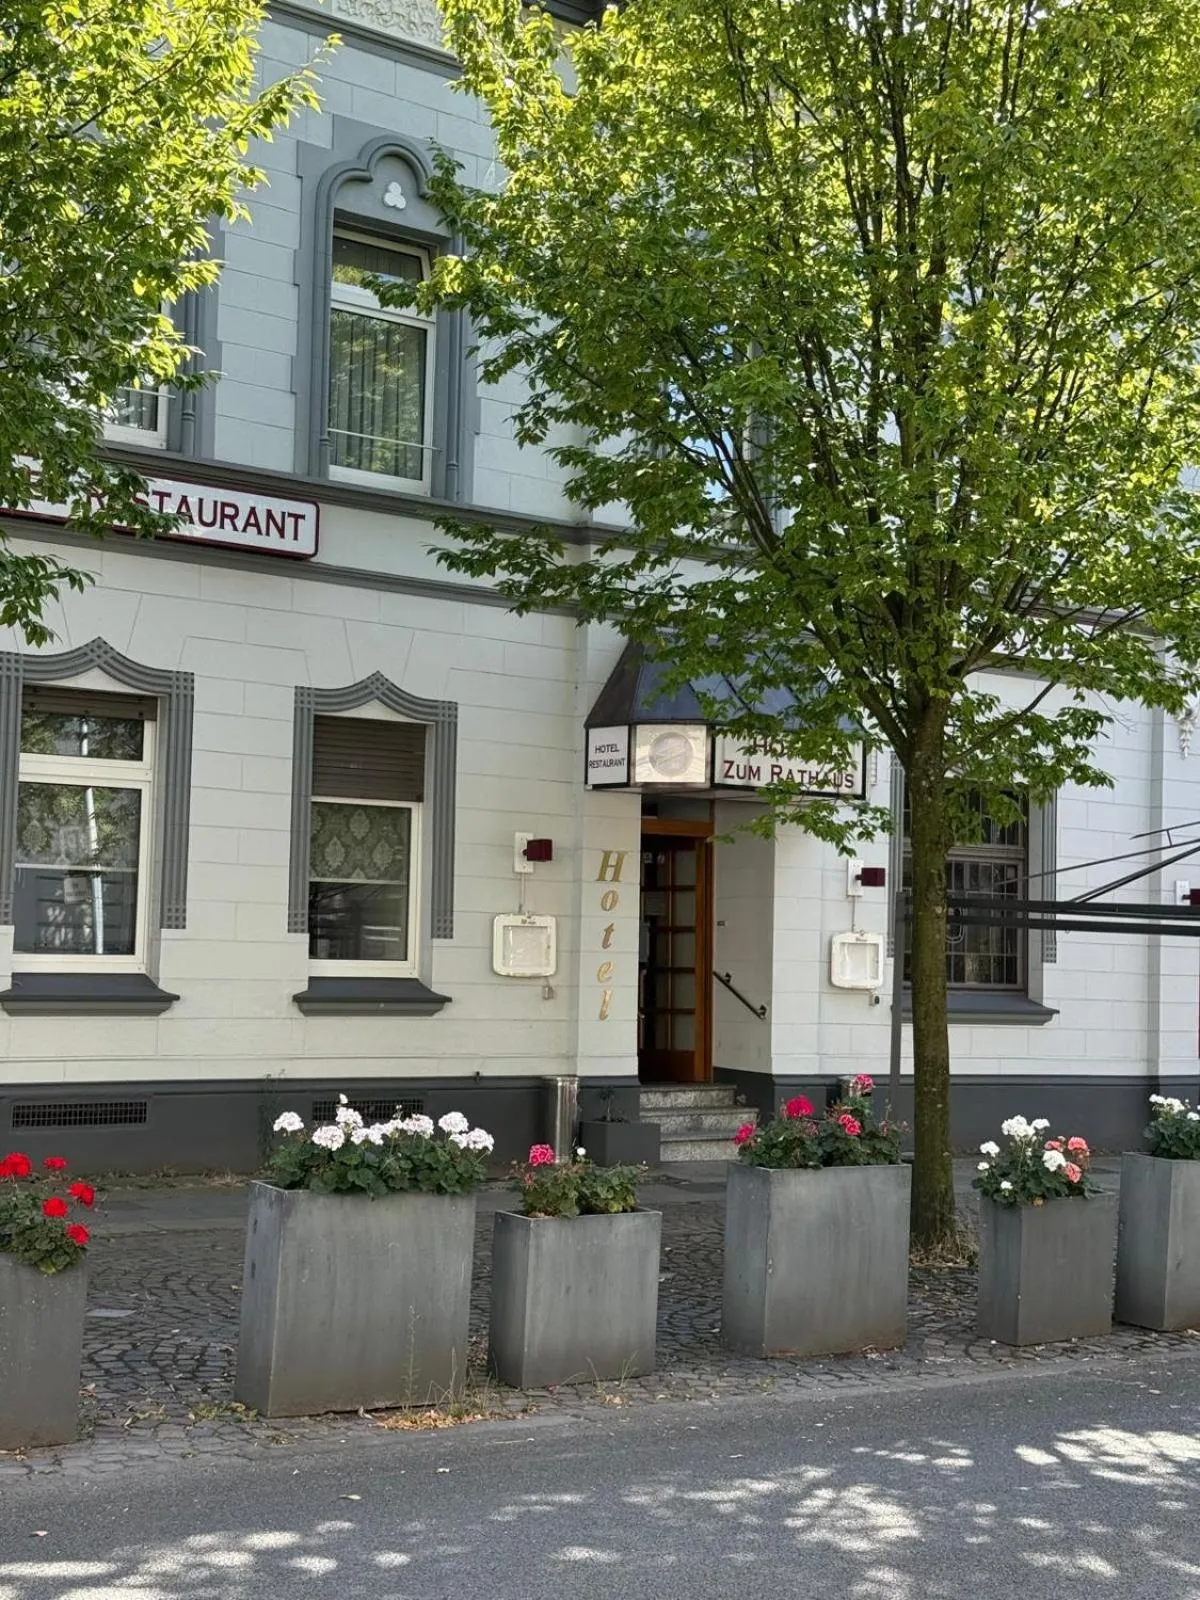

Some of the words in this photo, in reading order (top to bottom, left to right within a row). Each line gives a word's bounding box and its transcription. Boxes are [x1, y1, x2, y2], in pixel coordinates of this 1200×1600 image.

[595, 744, 620, 754] HOTEL
[589, 758, 625, 769] RESTAURANT
[723, 760, 761, 781] ZUM
[595, 851, 629, 1020] Hotel
